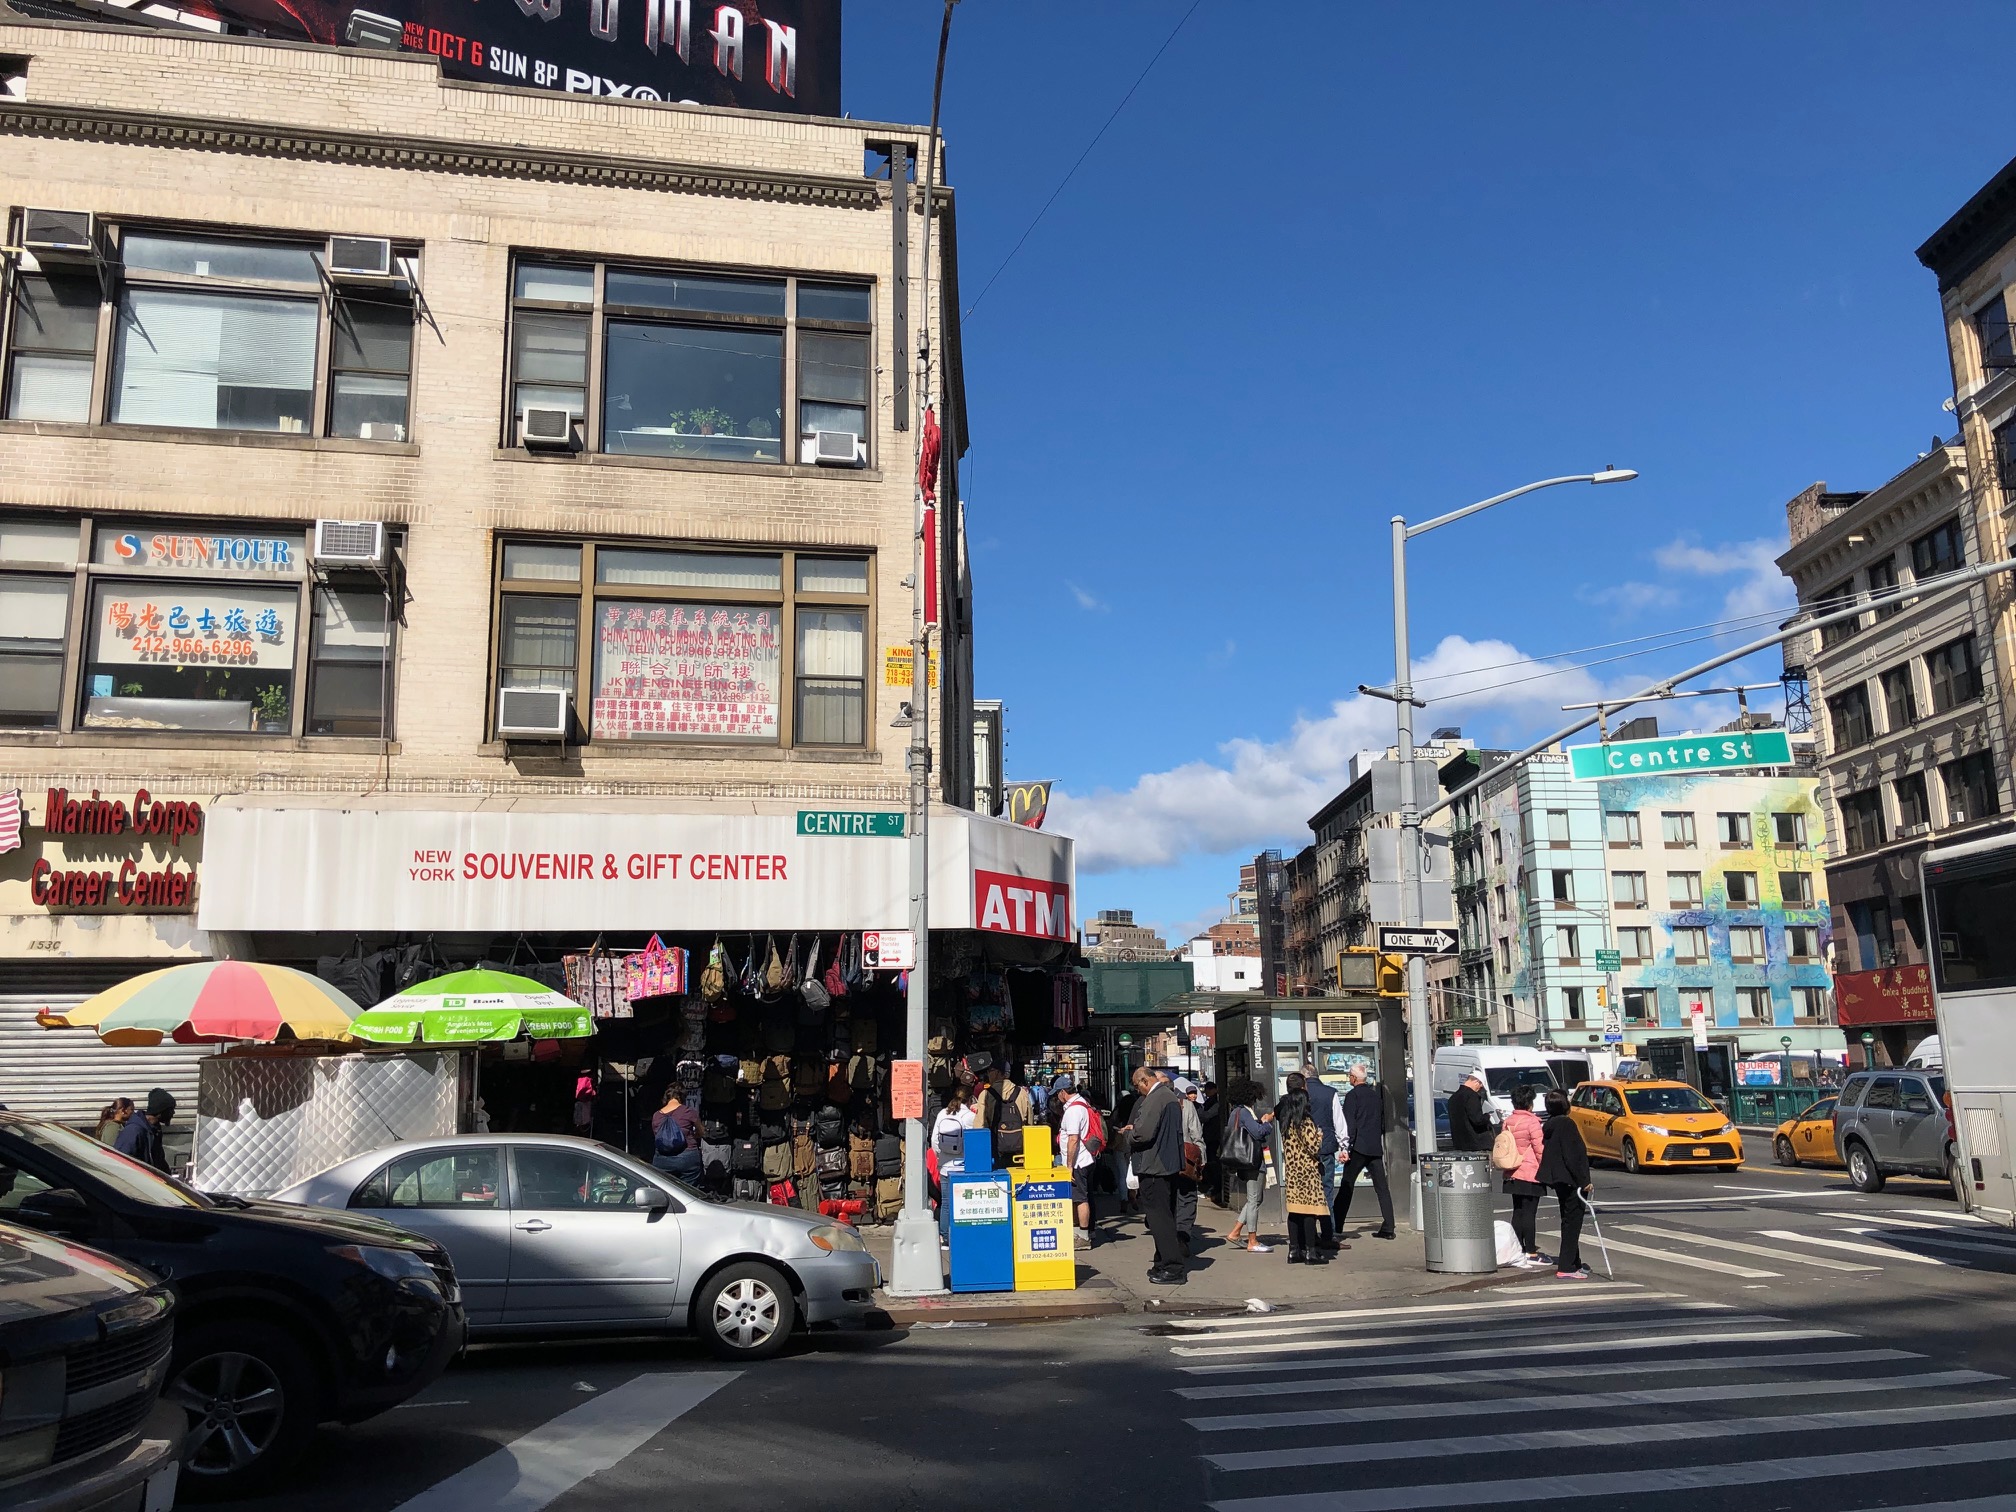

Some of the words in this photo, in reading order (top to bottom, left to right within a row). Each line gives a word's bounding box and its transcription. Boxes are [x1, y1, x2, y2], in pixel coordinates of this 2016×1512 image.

[404, 21, 425, 37] NEW
[400, 35, 423, 50] RIES
[428, 28, 466, 62] OCT
[471, 40, 483, 66] 6
[489, 46, 527, 80] SUN
[534, 59, 559, 87] 8P
[150, 534, 291, 565] SUNTOUR
[108, 601, 280, 636] 陽光巴士旅遊
[606, 606, 772, 630] 華埠暖氣系統公司
[601, 626, 656, 645] CHINATOWN
[660, 628, 704, 646] PLUMBING
[708, 630, 714, 646] &
[718, 632, 757, 648] HEATING
[132, 636, 253, 657] 212-966-6296
[607, 677, 637, 687] JKW
[1608, 745, 1711, 770] Centre
[1721, 740, 1753, 760] St
[45, 787, 126, 836] Marine
[132, 788, 202, 847] Corps
[804, 813, 877, 834] CENTRE
[888, 815, 900, 826] ST
[414, 850, 452, 864] NEW
[462, 852, 594, 881] SOUVENIR
[601, 853, 620, 881] &
[627, 853, 683, 881] GIFT
[690, 854, 788, 881] CENTER
[31, 857, 114, 906] Career
[118, 858, 197, 907] Center
[409, 868, 455, 882] YORK
[981, 884, 1067, 938] ATM
[30, 940, 61, 951] 153C
[1390, 934, 1414, 946] ONE
[1423, 935, 1448, 947] WAY
[1902, 985, 1930, 996] Buddhist
[444, 999, 464, 1007] TD
[1903, 1009, 1911, 1018] Fa
[1912, 1009, 1928, 1018] Wang
[384, 1026, 404, 1035] FOOD
[1605, 1024, 1620, 1033] 25
[1252, 1016, 1264, 1069] Newsstand
[962, 1188, 999, 1200] 看中國
[960, 1206, 1003, 1216] 全球都在看中國
